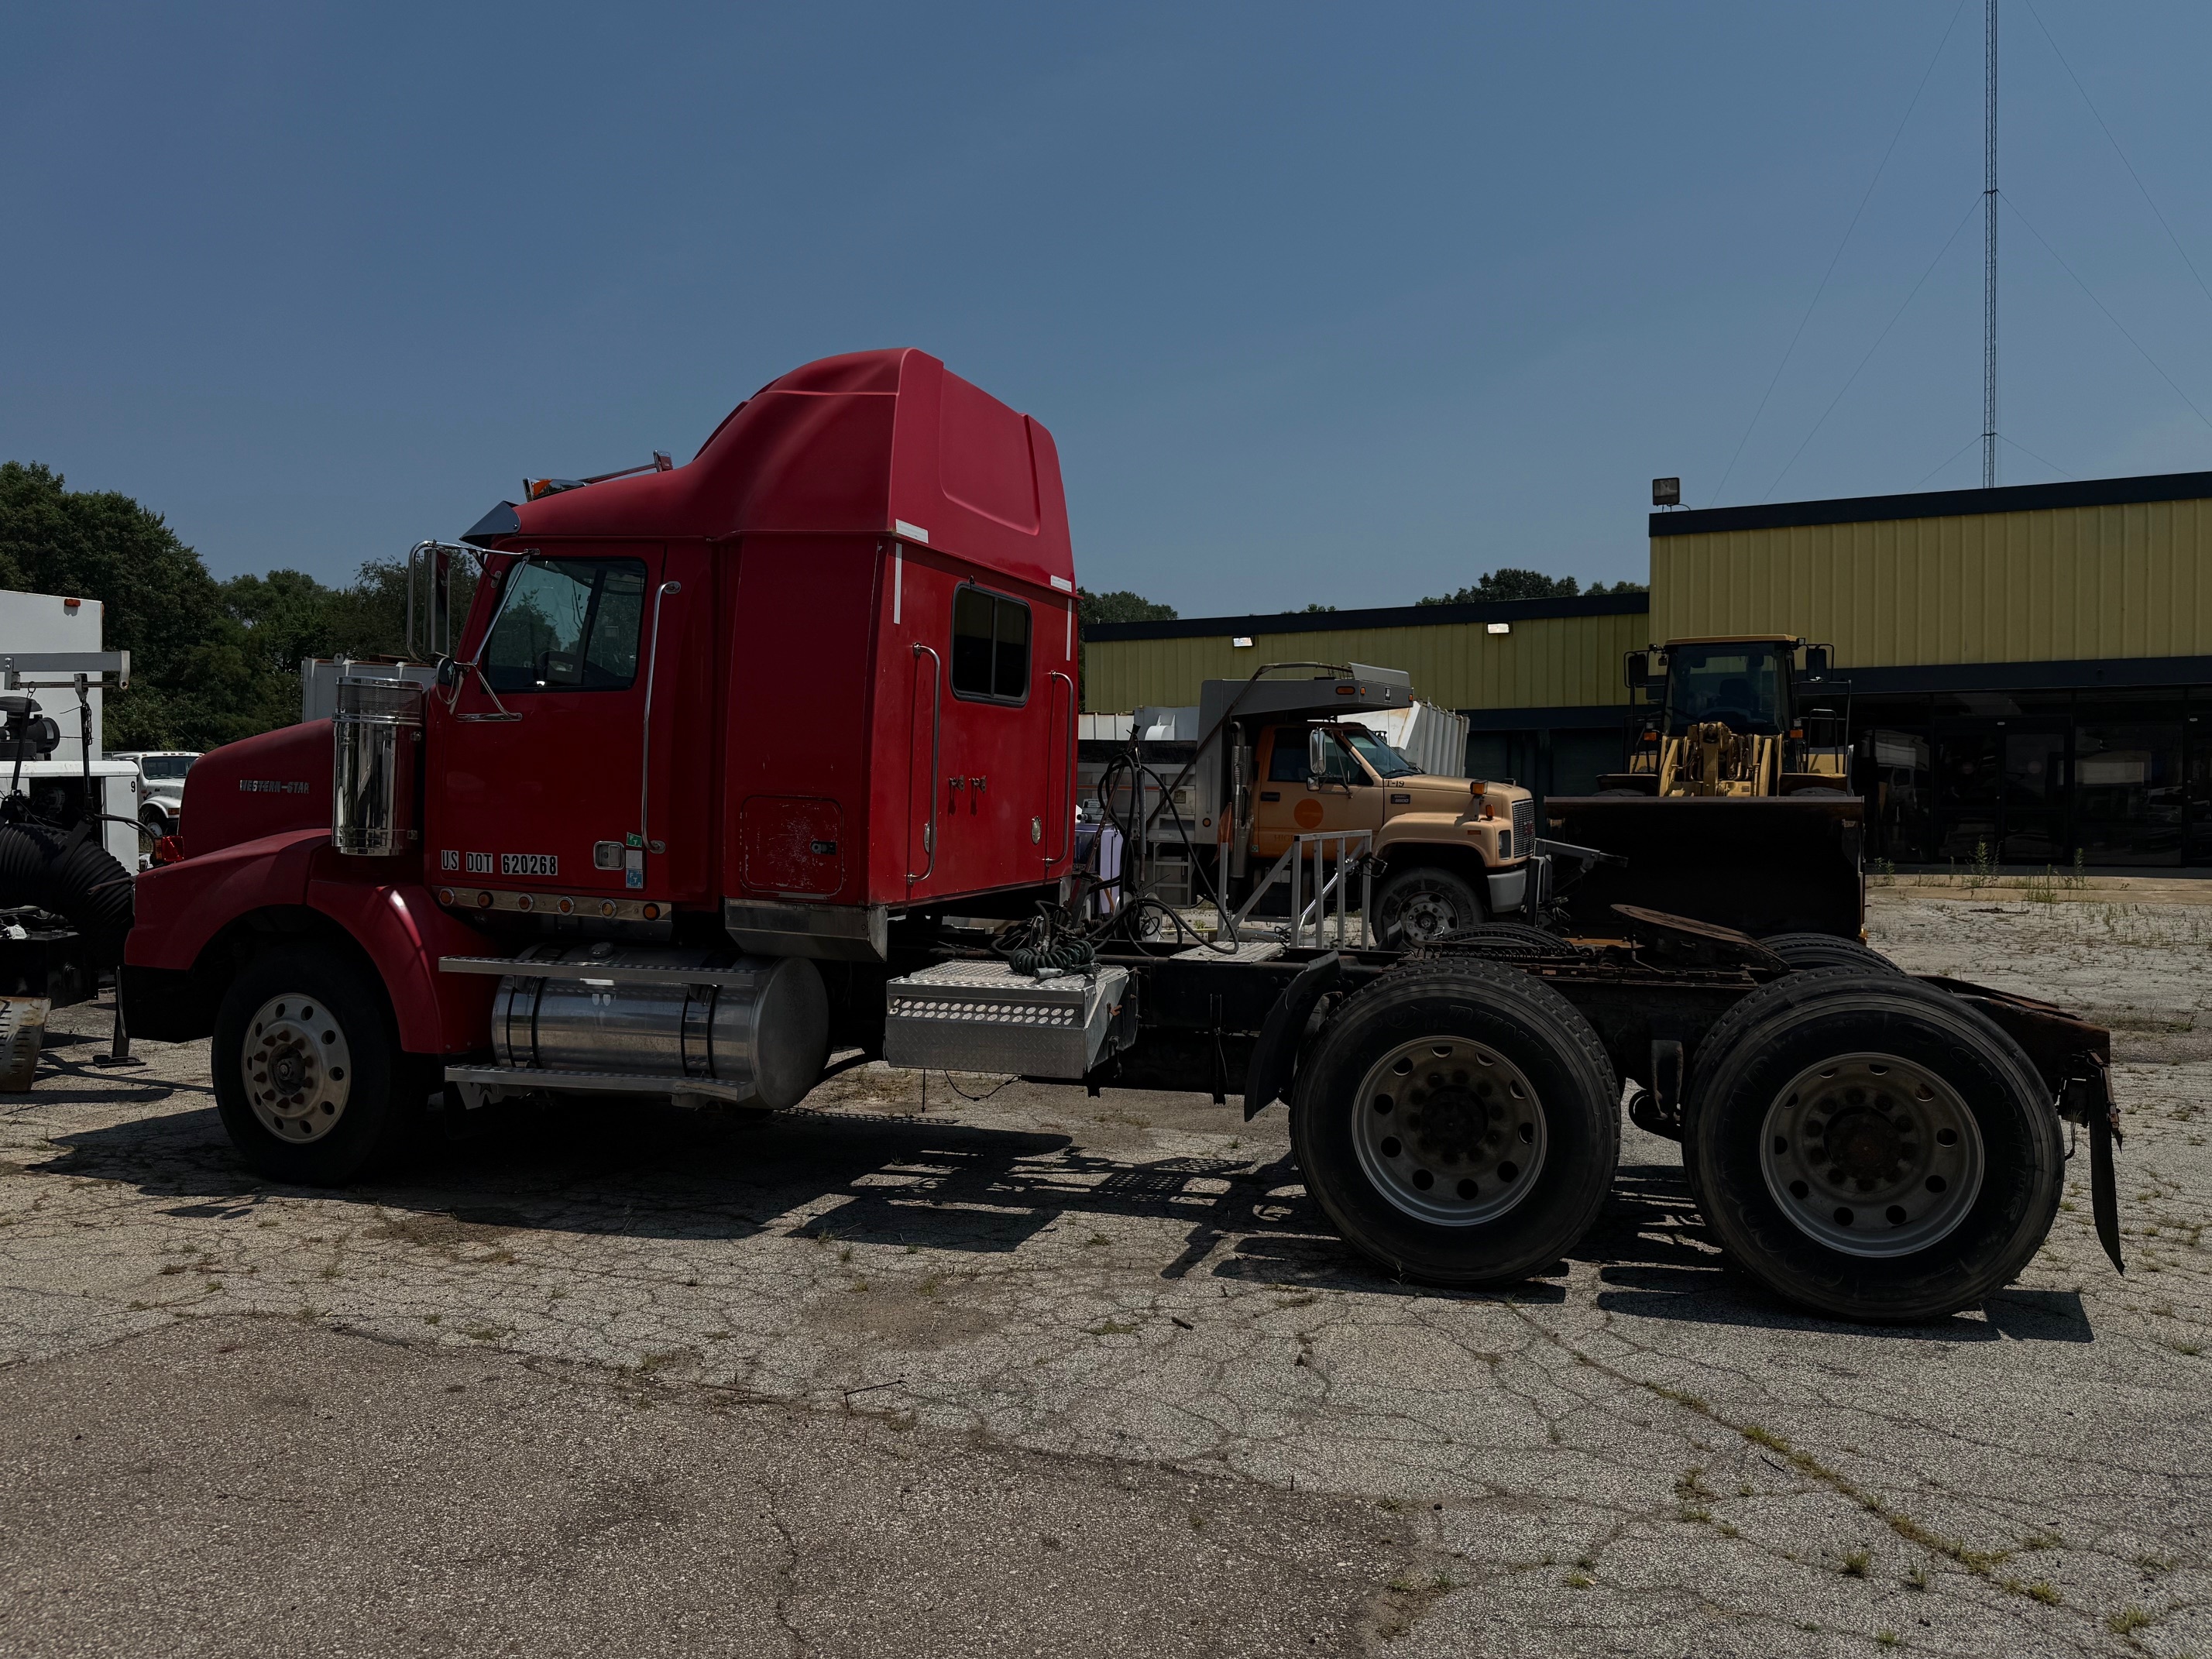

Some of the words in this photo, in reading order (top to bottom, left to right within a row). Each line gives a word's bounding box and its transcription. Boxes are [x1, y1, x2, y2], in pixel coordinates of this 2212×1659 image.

[131, 781, 136, 793] 9
[442, 850, 459, 870] US
[466, 853, 492, 873] DOT
[502, 854, 557, 875] 620268
